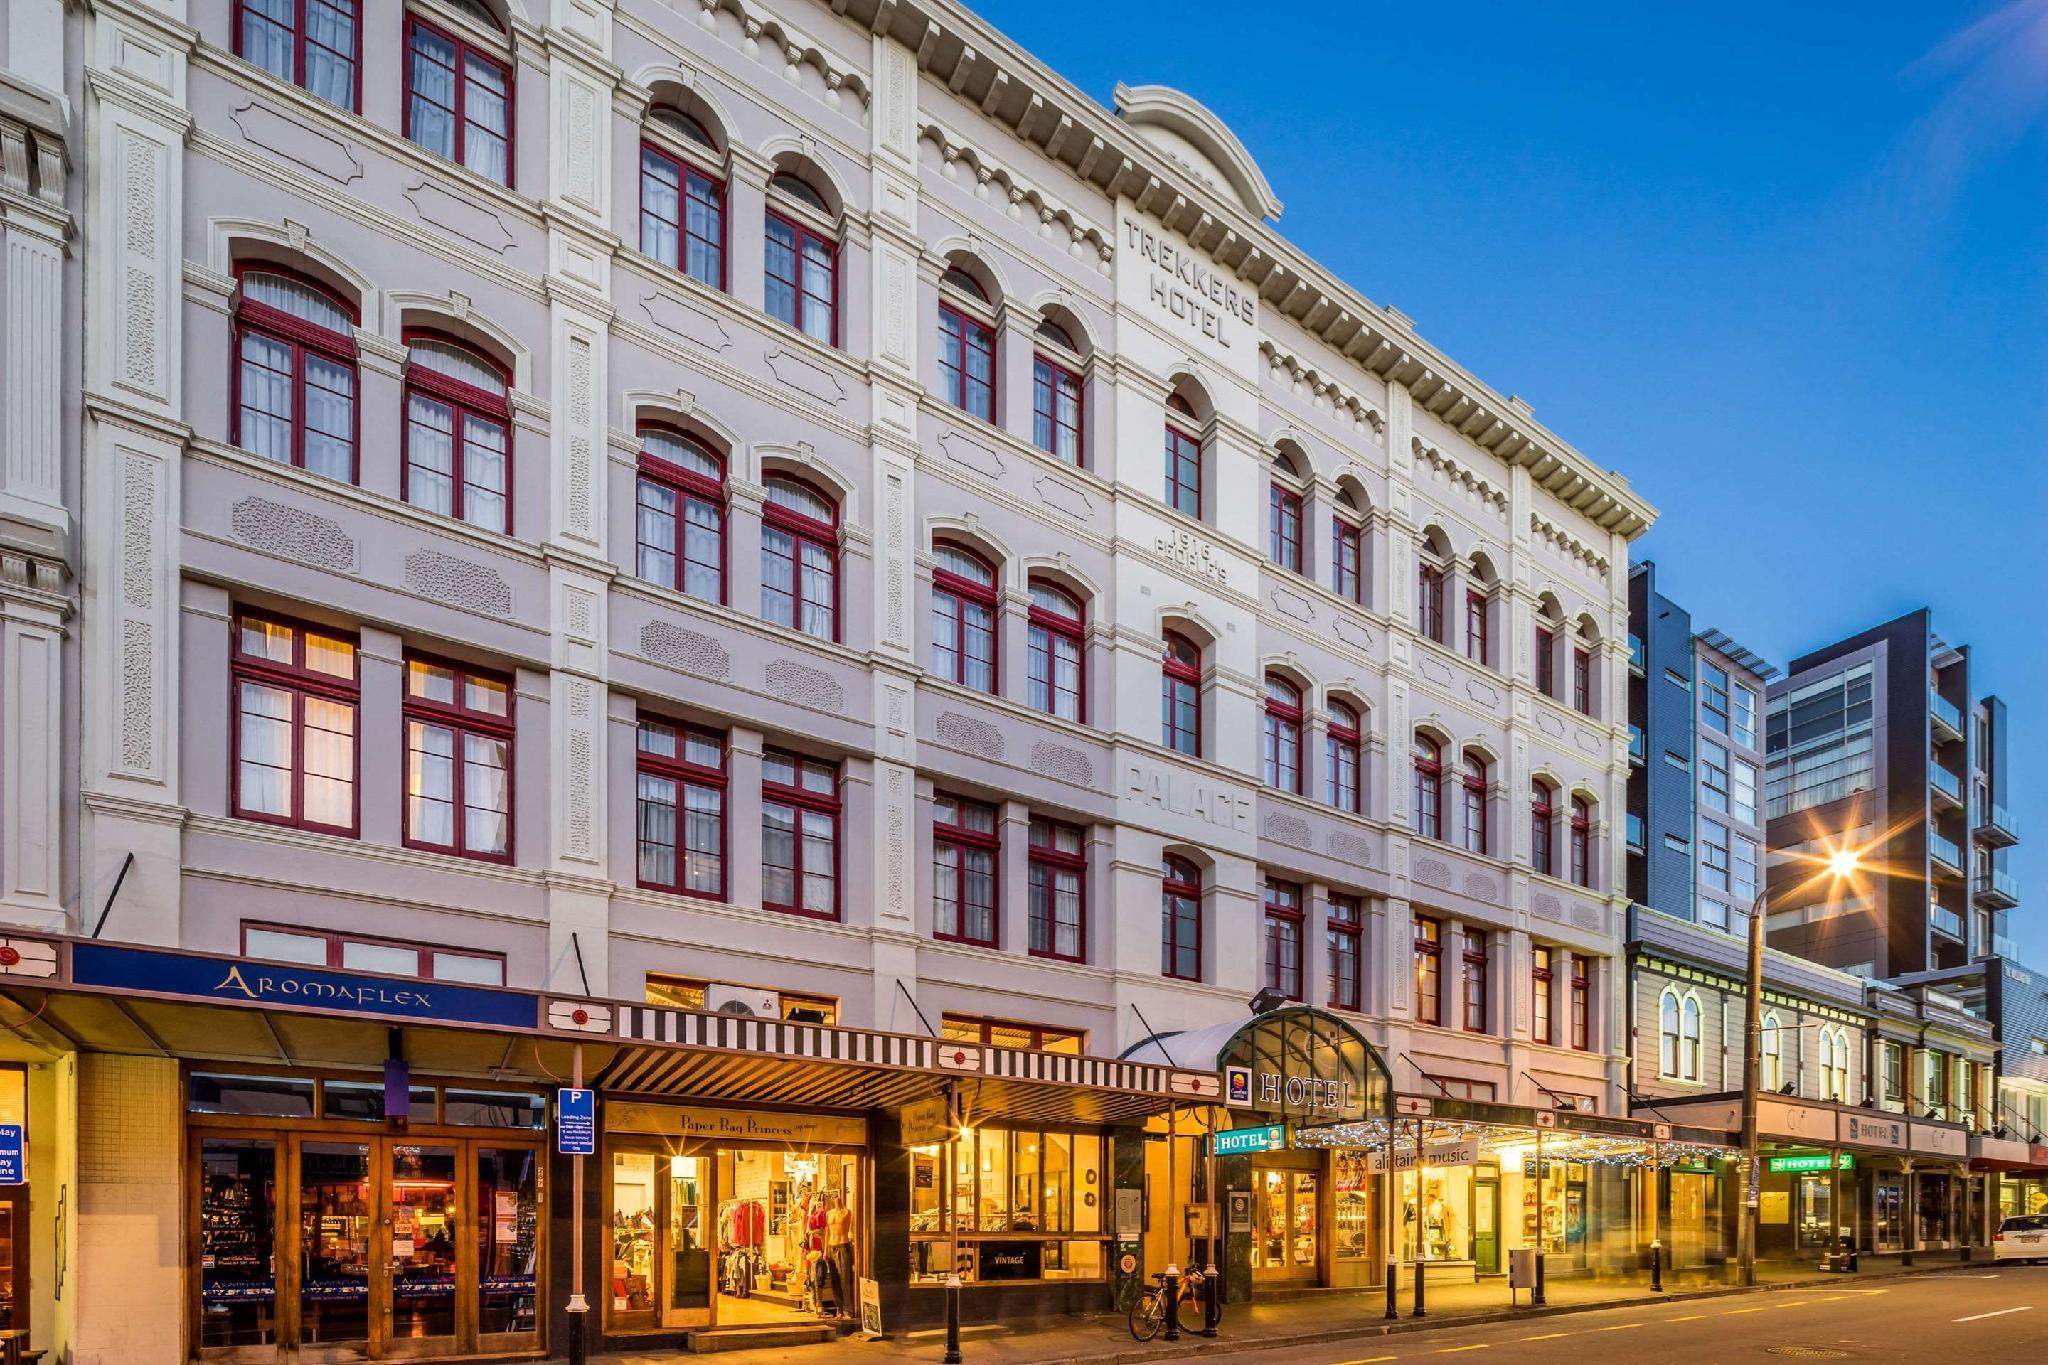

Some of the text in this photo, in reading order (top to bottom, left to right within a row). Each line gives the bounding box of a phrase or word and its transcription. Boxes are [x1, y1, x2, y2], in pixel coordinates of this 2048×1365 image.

[1123, 217, 1255, 327] TREKKERS
[1150, 271, 1232, 349] HOTEL
[571, 1091, 582, 1104] P
[1260, 1072, 1357, 1109] HOTEL
[680, 1114, 716, 1131] Paper
[747, 1115, 793, 1136] Princess
[1221, 1133, 1267, 1150] HOTEL
[1429, 1148, 1469, 1164] music
[994, 1255, 1025, 1265] VINTAGE
